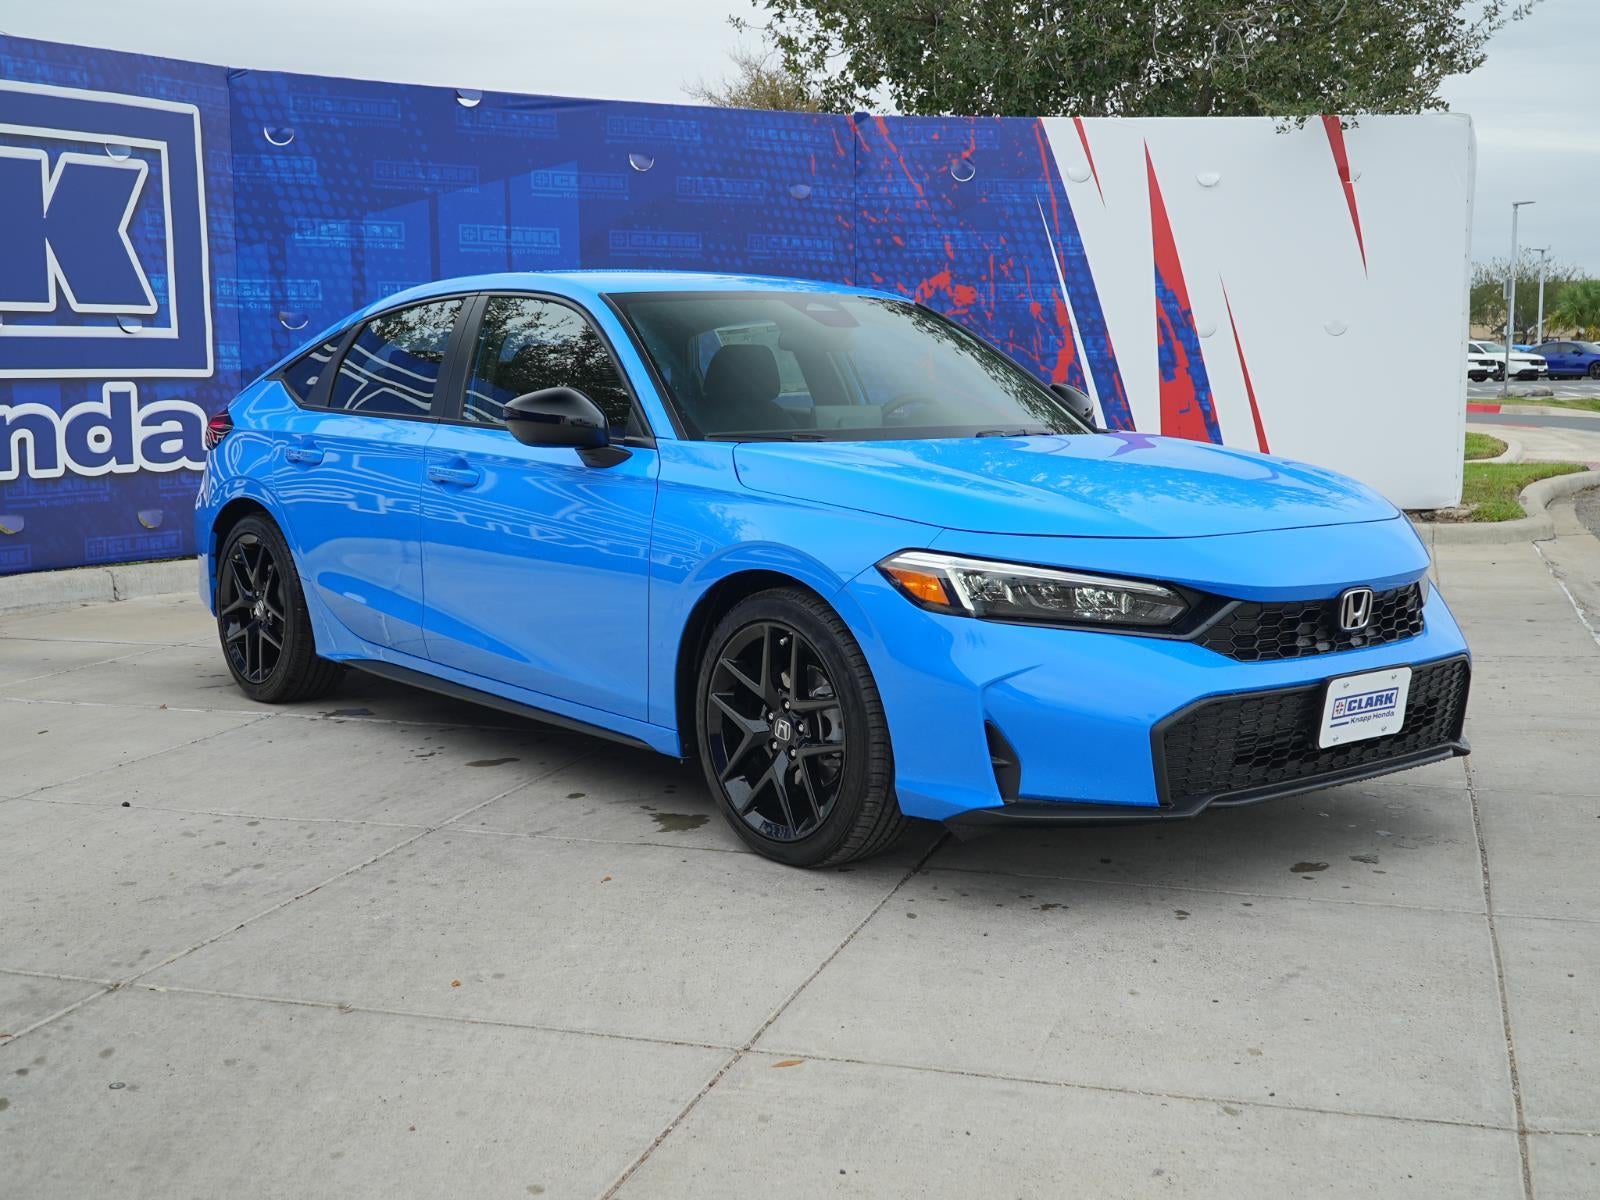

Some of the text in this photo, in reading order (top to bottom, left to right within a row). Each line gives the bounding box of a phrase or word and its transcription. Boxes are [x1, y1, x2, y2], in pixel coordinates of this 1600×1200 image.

[1347, 692, 1395, 712] CLARK
[1350, 710, 1395, 725] Knapp Honda
